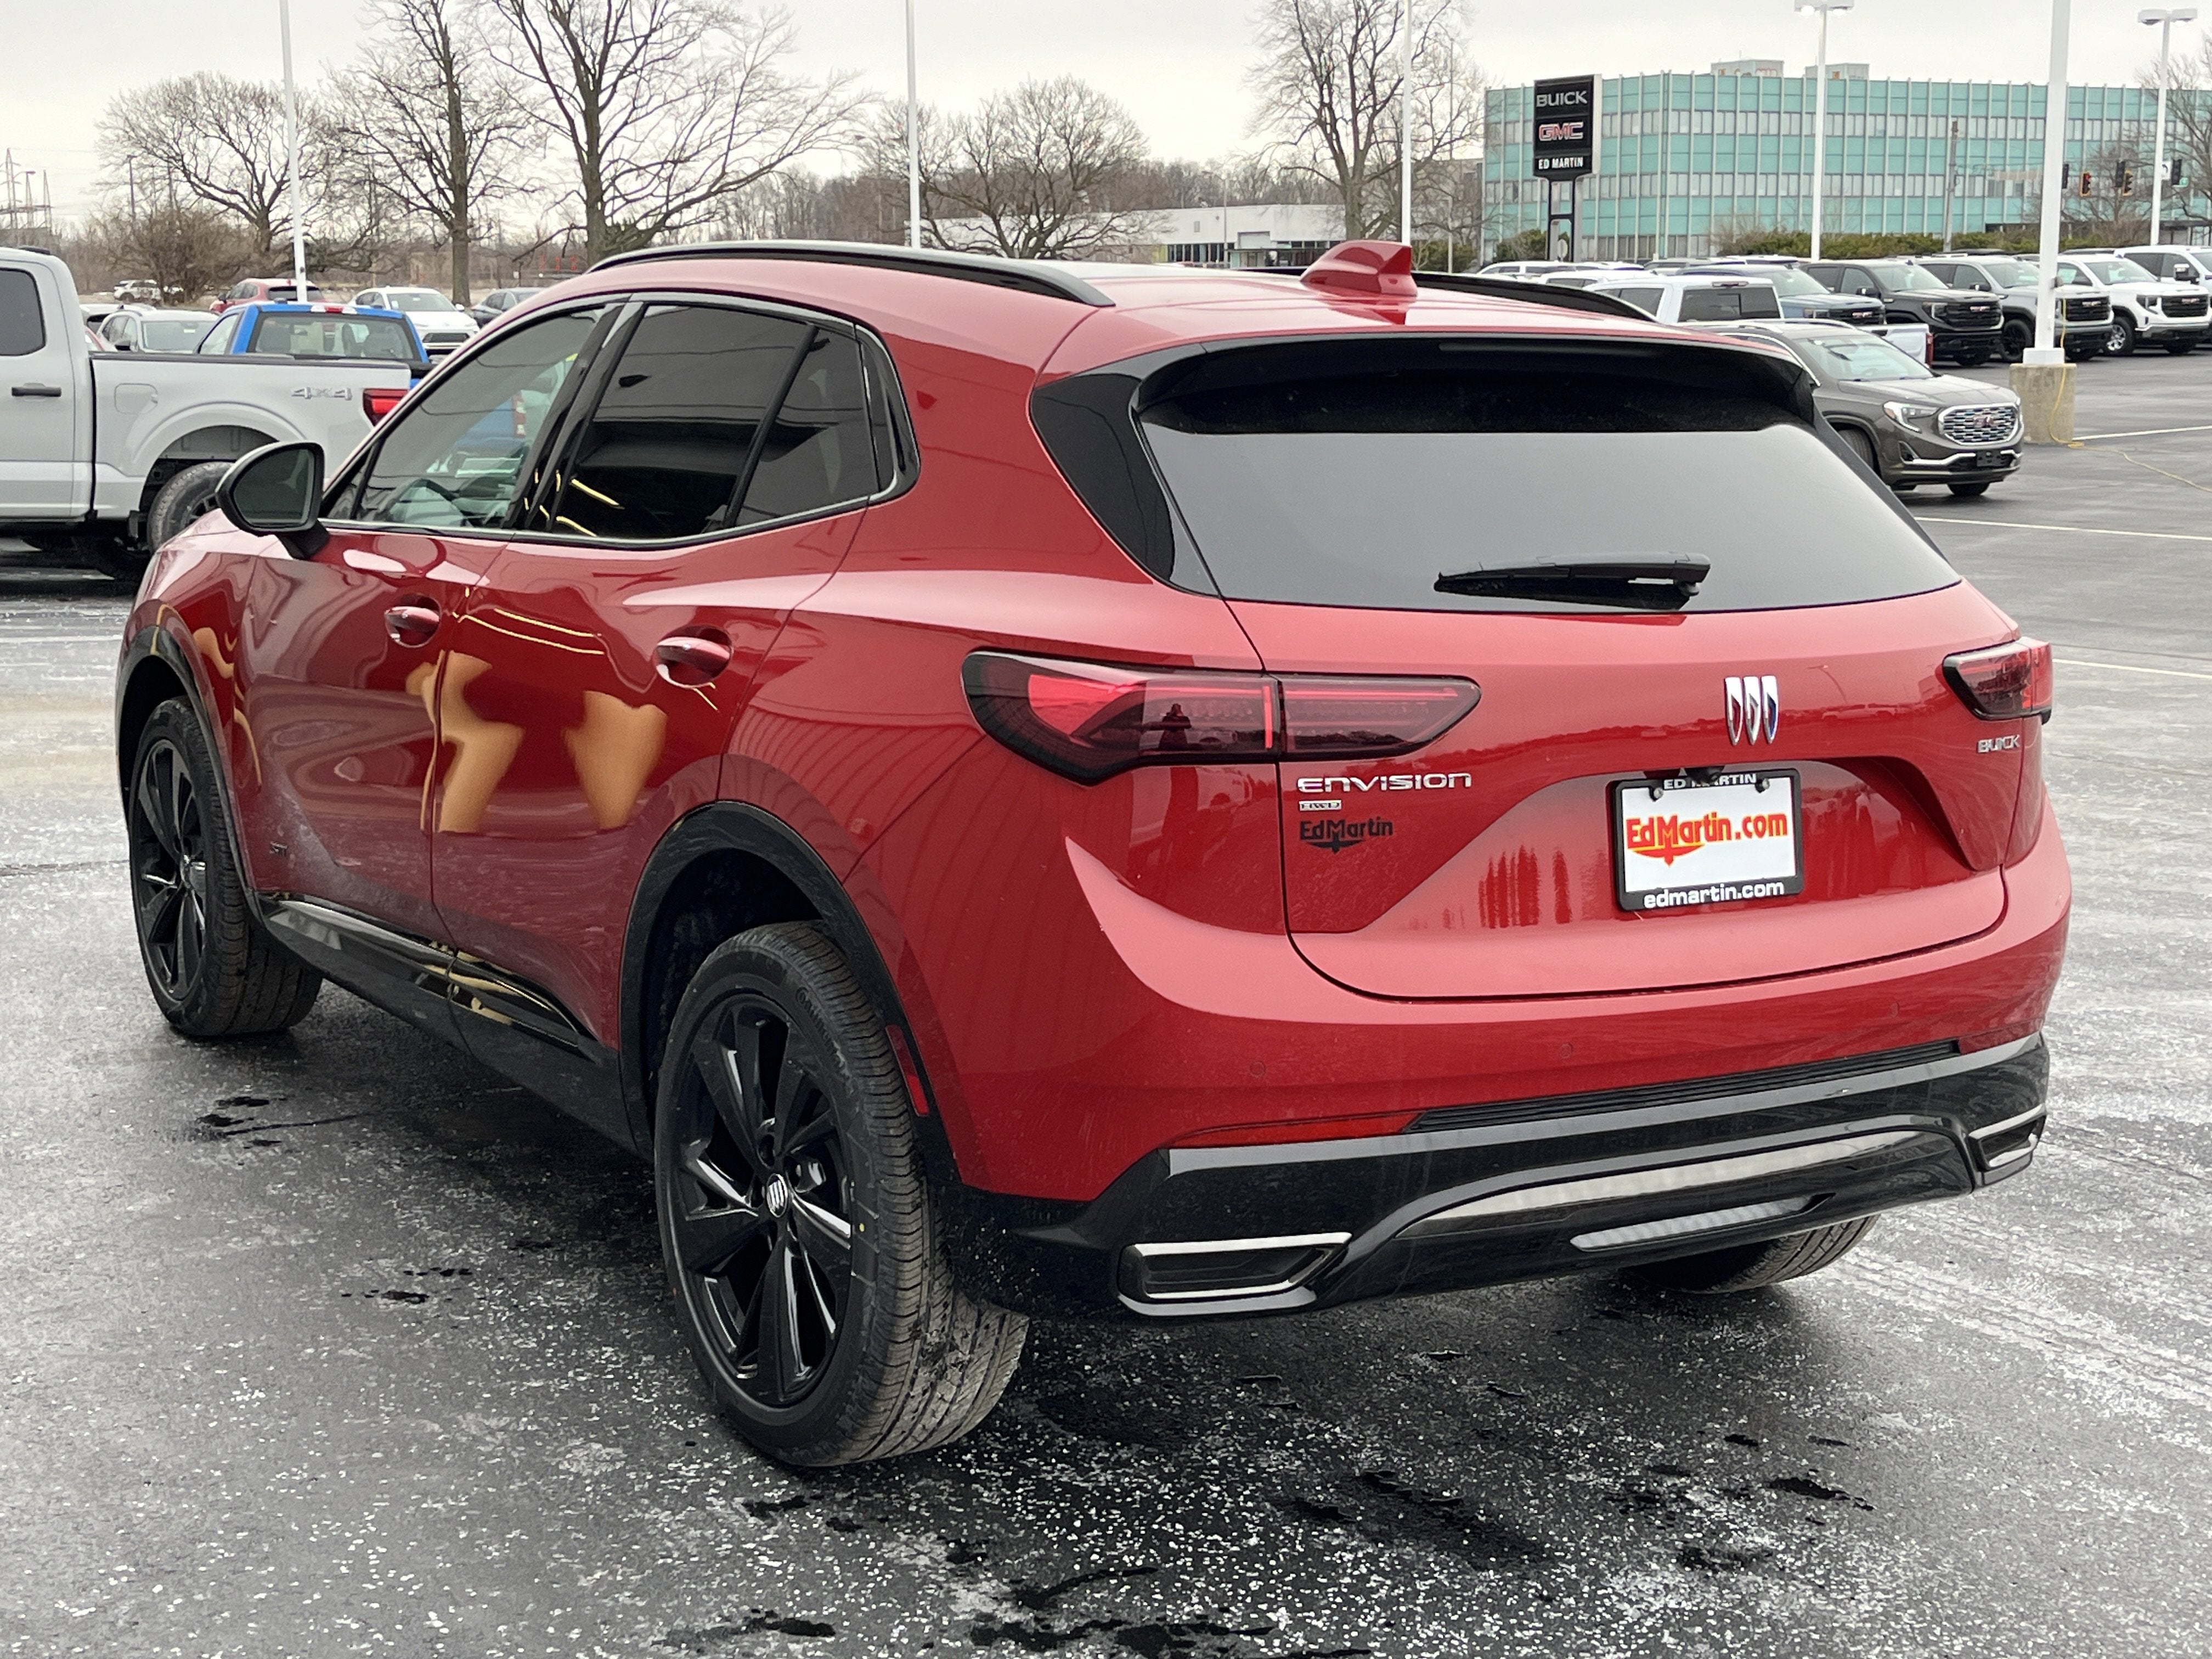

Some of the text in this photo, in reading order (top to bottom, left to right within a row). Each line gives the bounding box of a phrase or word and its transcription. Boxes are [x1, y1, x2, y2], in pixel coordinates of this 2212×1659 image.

[1536, 91, 1588, 108] BUICK
[1538, 121, 1584, 142] GMC
[1538, 157, 1584, 170] ED MARTIN
[1977, 734, 2021, 753] BUICK
[1297, 773, 1472, 792] ENVISION
[1663, 773, 1757, 790] ED RTIN
[1626, 811, 1788, 849] EdMartin.com
[1643, 881, 1785, 909] edmartin.com
